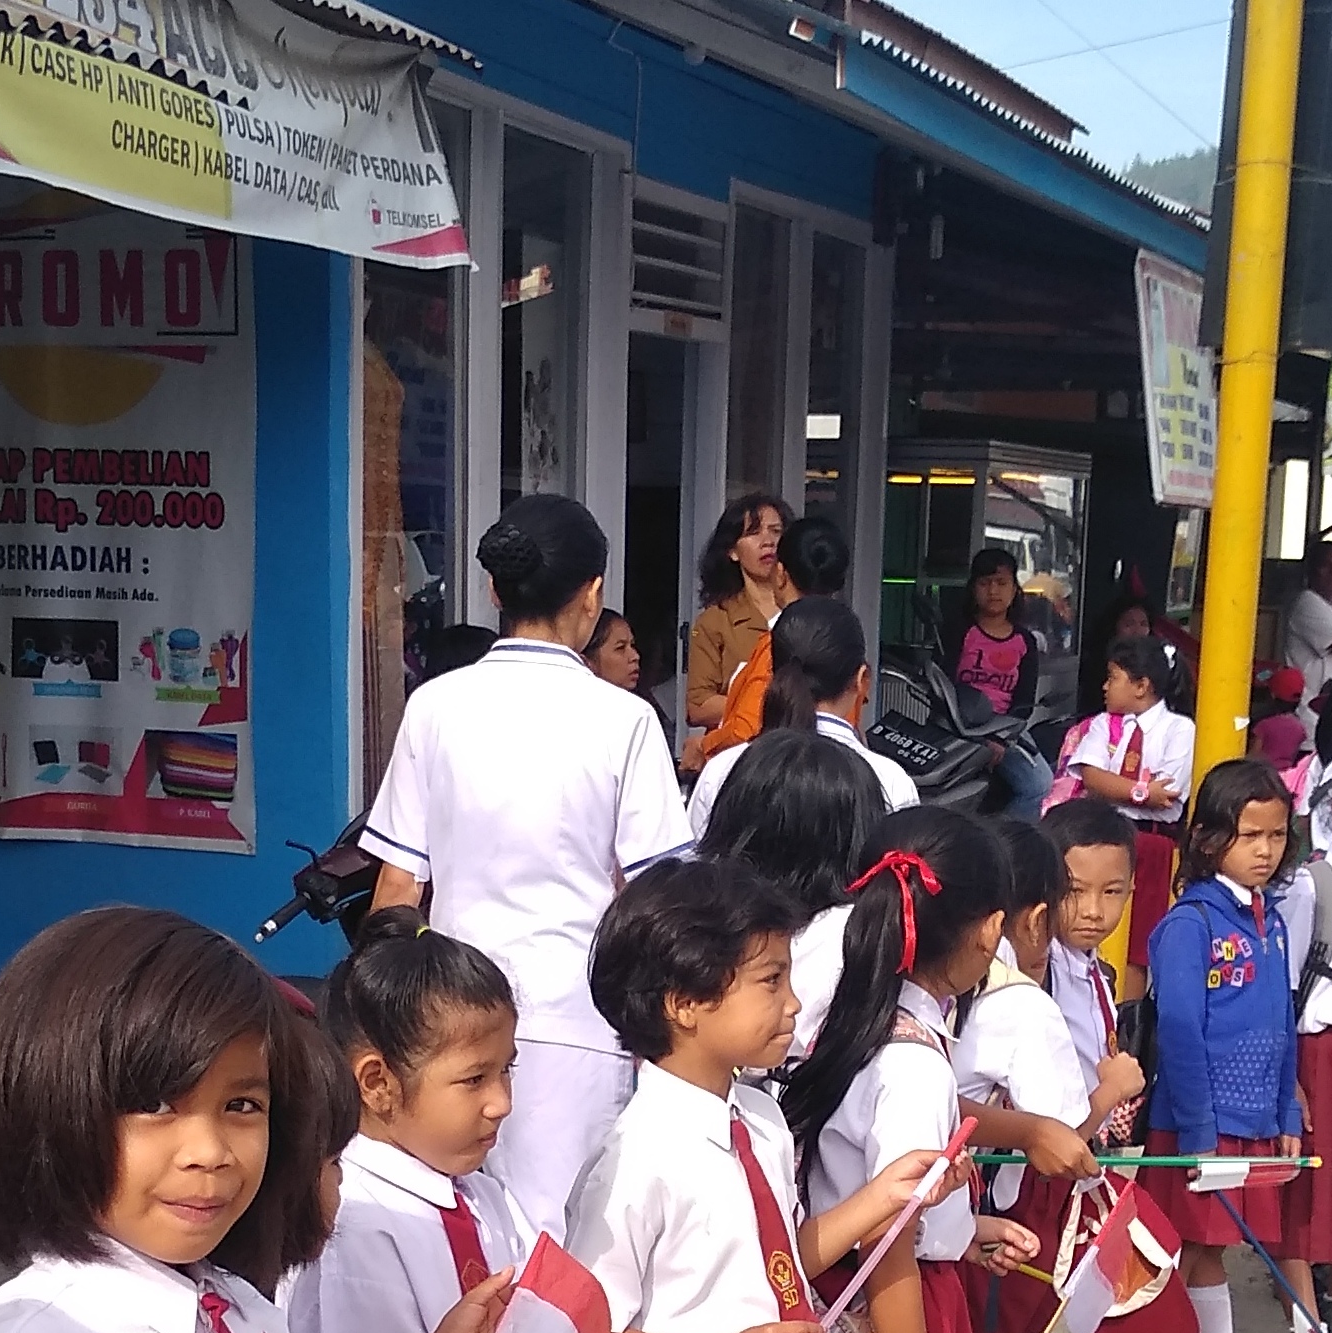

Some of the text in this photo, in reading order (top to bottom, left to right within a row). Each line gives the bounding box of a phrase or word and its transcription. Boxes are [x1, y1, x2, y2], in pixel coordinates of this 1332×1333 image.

[31, 43, 78, 85] CASE
[80, 61, 104, 94] HP
[116, 73, 156, 112] ANTI
[160, 87, 215, 130] GORES
[226, 112, 274, 147] PULSA
[284, 126, 324, 162] TOKEN
[361, 153, 444, 187] PERDANA
[111, 119, 340, 212] CHARGER KABEL DATA CAS, dll
[386, 209, 446, 229] TELKOMSEL
[32, 447, 210, 487] PEMBELIAN
[34, 488, 88, 533] Rp.
[96, 489, 225, 531] 200.000
[24, 585, 91, 599] Persediaan
[95, 587, 128, 601] Masih
[132, 588, 159, 602] Ada.
[783, 1287, 800, 1311] SD
